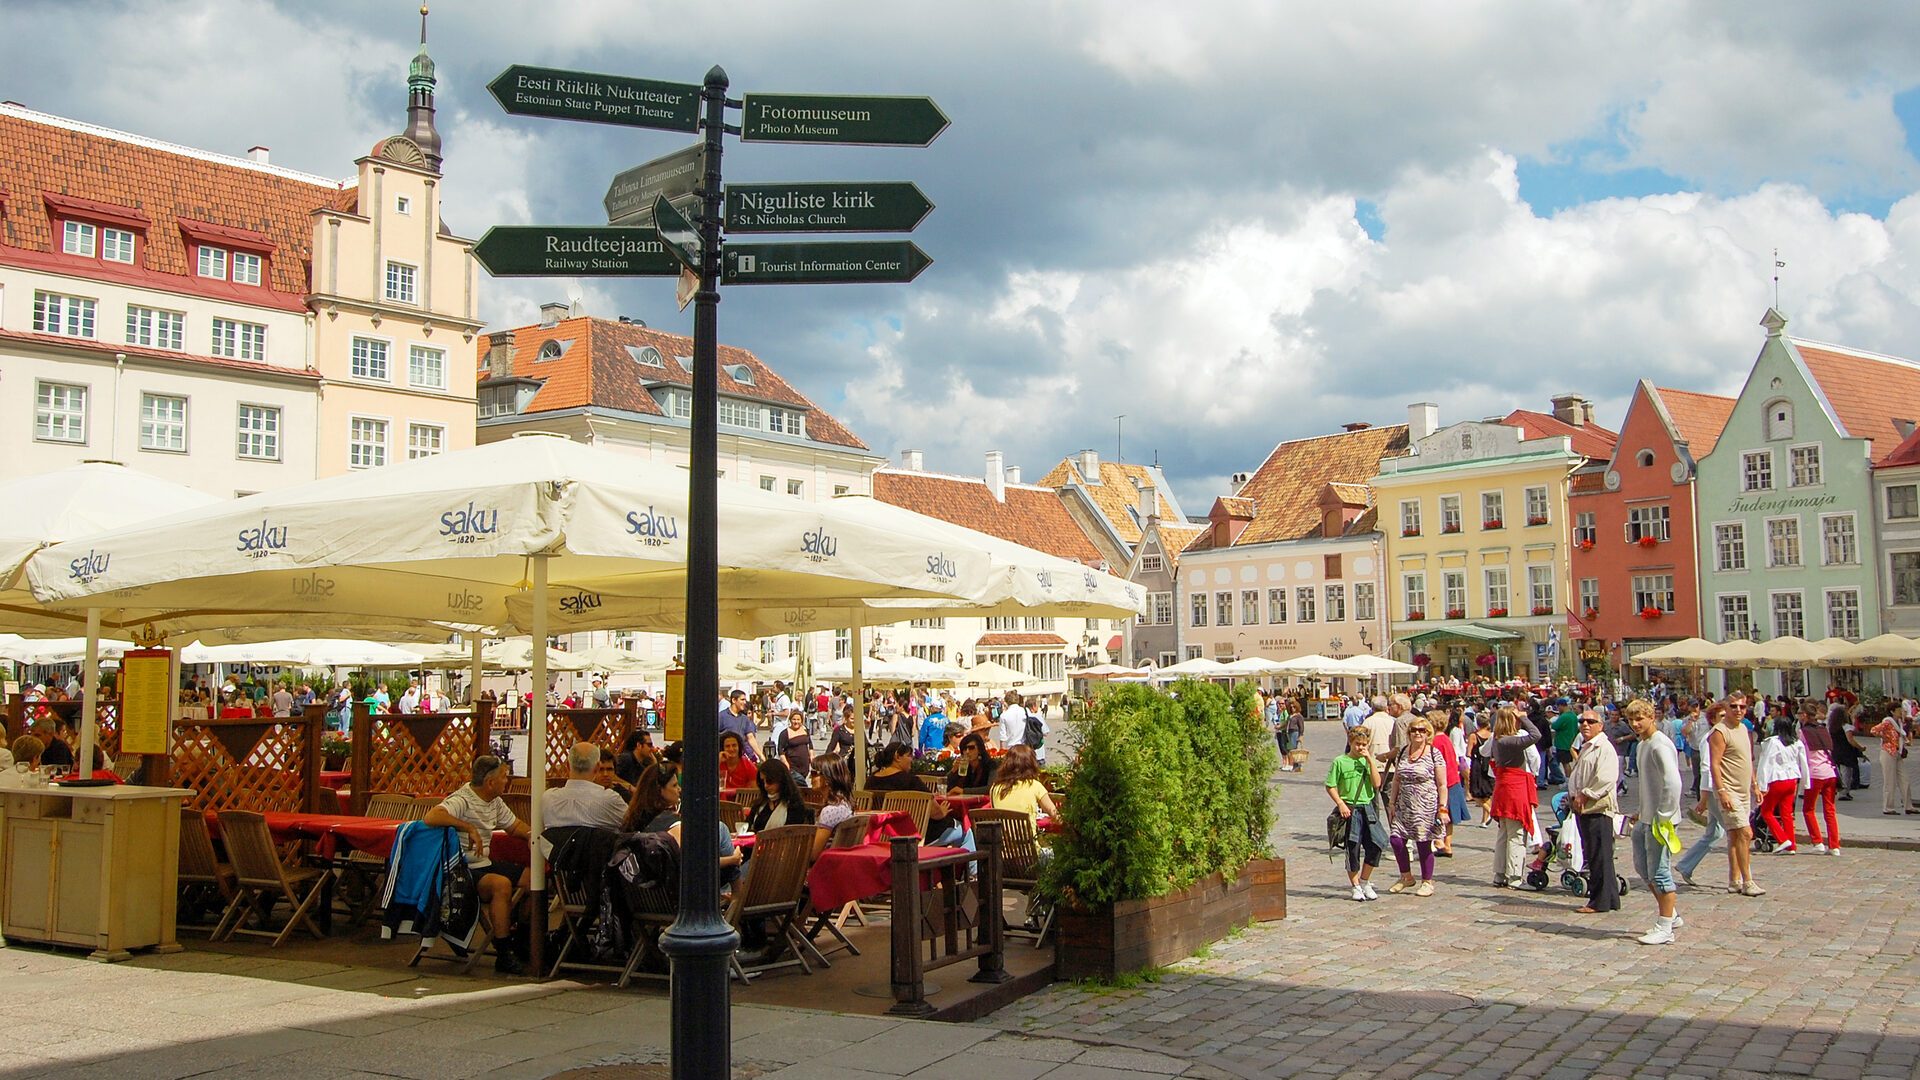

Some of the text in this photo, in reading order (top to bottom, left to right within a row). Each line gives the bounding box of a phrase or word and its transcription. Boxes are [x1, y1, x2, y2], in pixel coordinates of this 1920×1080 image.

[517, 75, 682, 105] Eesti Riiklik Nukuteater
[515, 92, 674, 119] Estonian State Puppet Theatre
[761, 104, 871, 121] Fotomuuseum
[760, 123, 839, 135] Photo Museum
[740, 191, 875, 214] Niguliste kirik
[739, 213, 846, 225] St. Nicholas Church
[545, 235, 664, 257] Raudteejaam
[545, 257, 629, 271] Railway Station
[760, 260, 901, 272] Tourist Information Center
[1728, 493, 1838, 515] Tudengimaja
[439, 501, 498, 536] saku
[625, 505, 679, 540] saku
[237, 518, 287, 551] saku
[456, 534, 476, 544] 1820
[643, 537, 662, 547] 1820
[800, 526, 837, 557] saku
[69, 549, 111, 579] saku
[926, 551, 957, 579] saku
[558, 591, 602, 611] saku
